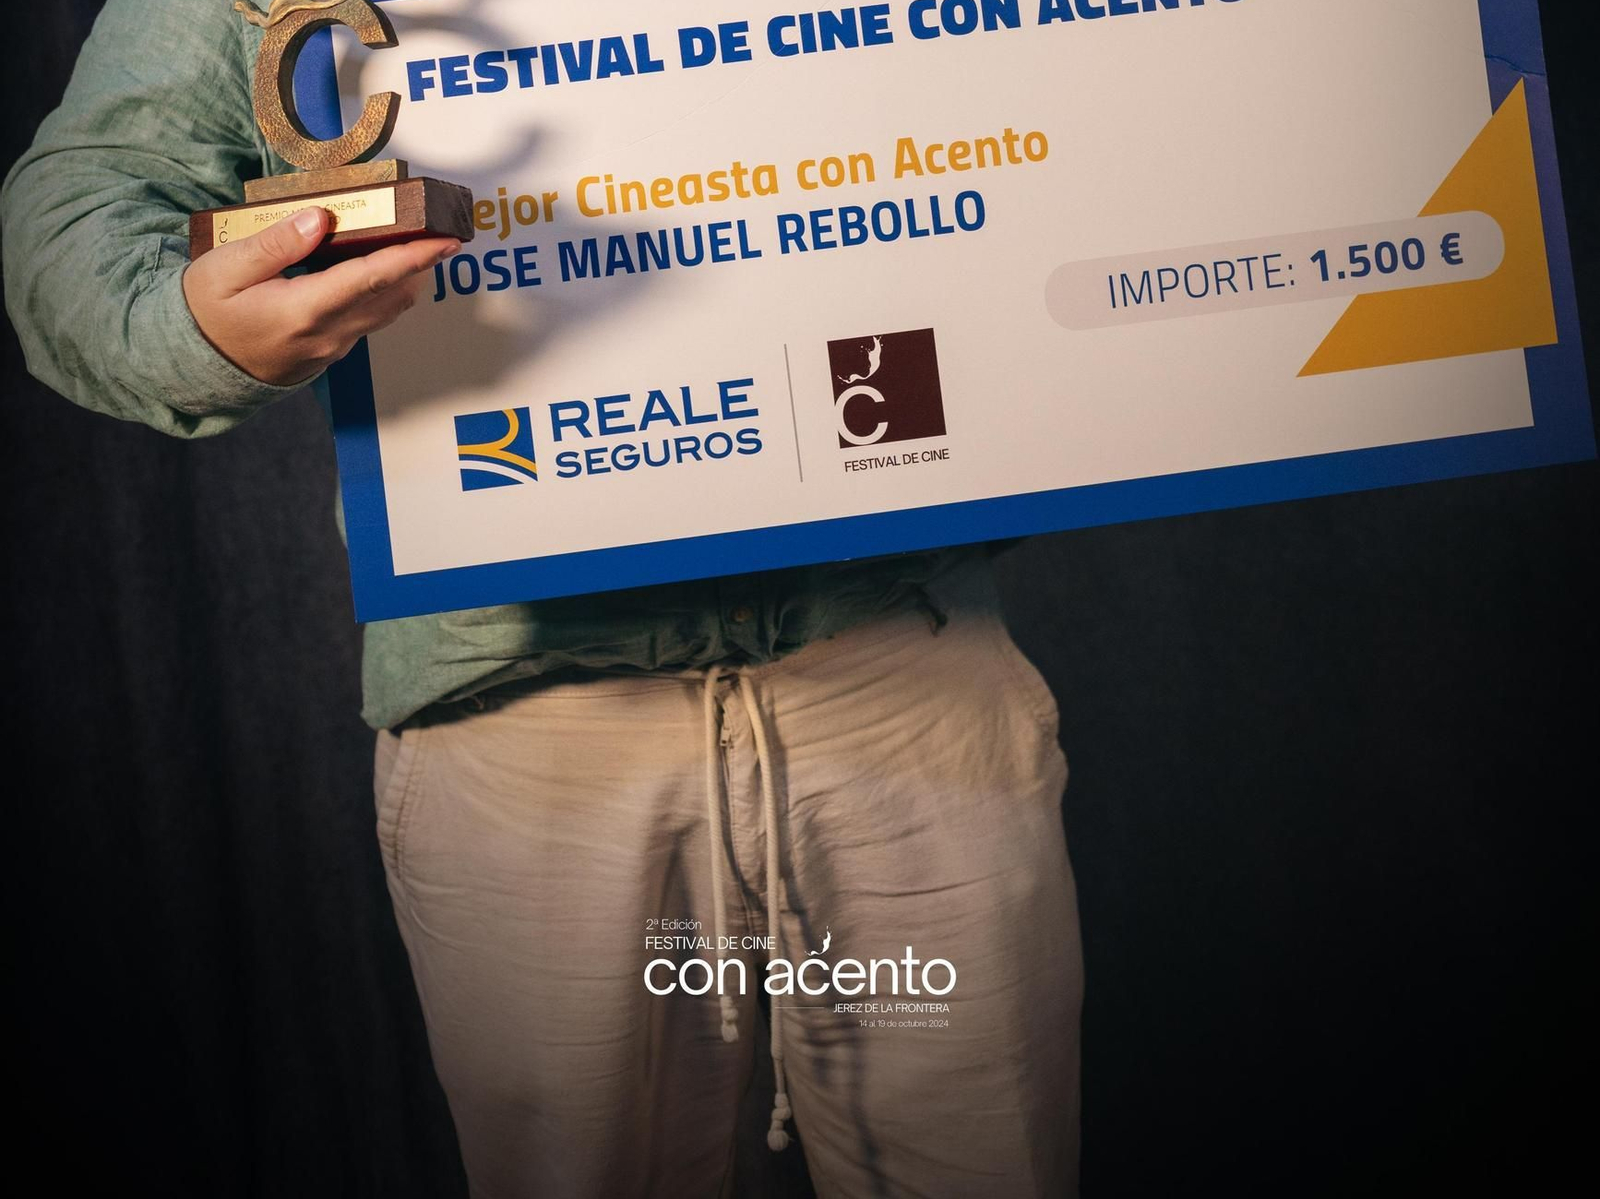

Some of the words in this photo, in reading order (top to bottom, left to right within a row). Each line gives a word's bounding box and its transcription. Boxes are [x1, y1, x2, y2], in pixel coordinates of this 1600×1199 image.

[406, 32, 665, 102] FESTIVAL
[678, 20, 753, 69] DE
[766, 3, 894, 58] CINE
[325, 199, 367, 213] CINEASTA
[473, 186, 559, 241] ejor
[576, 161, 780, 218] Cineasta
[796, 152, 876, 191] con
[894, 127, 1049, 179] Acento
[433, 245, 542, 302] JOSE
[557, 219, 762, 283] MANUEL
[776, 189, 986, 255] REBOLLO
[1108, 253, 1296, 309] IMPORTE:
[1310, 237, 1426, 282] 1.500
[1439, 232, 1464, 265] €
[547, 377, 759, 442] REALE
[554, 427, 764, 479] SEGUROS
[844, 455, 901, 473] FESTIVAL
[902, 452, 920, 465] DE
[921, 448, 950, 463] CINE
